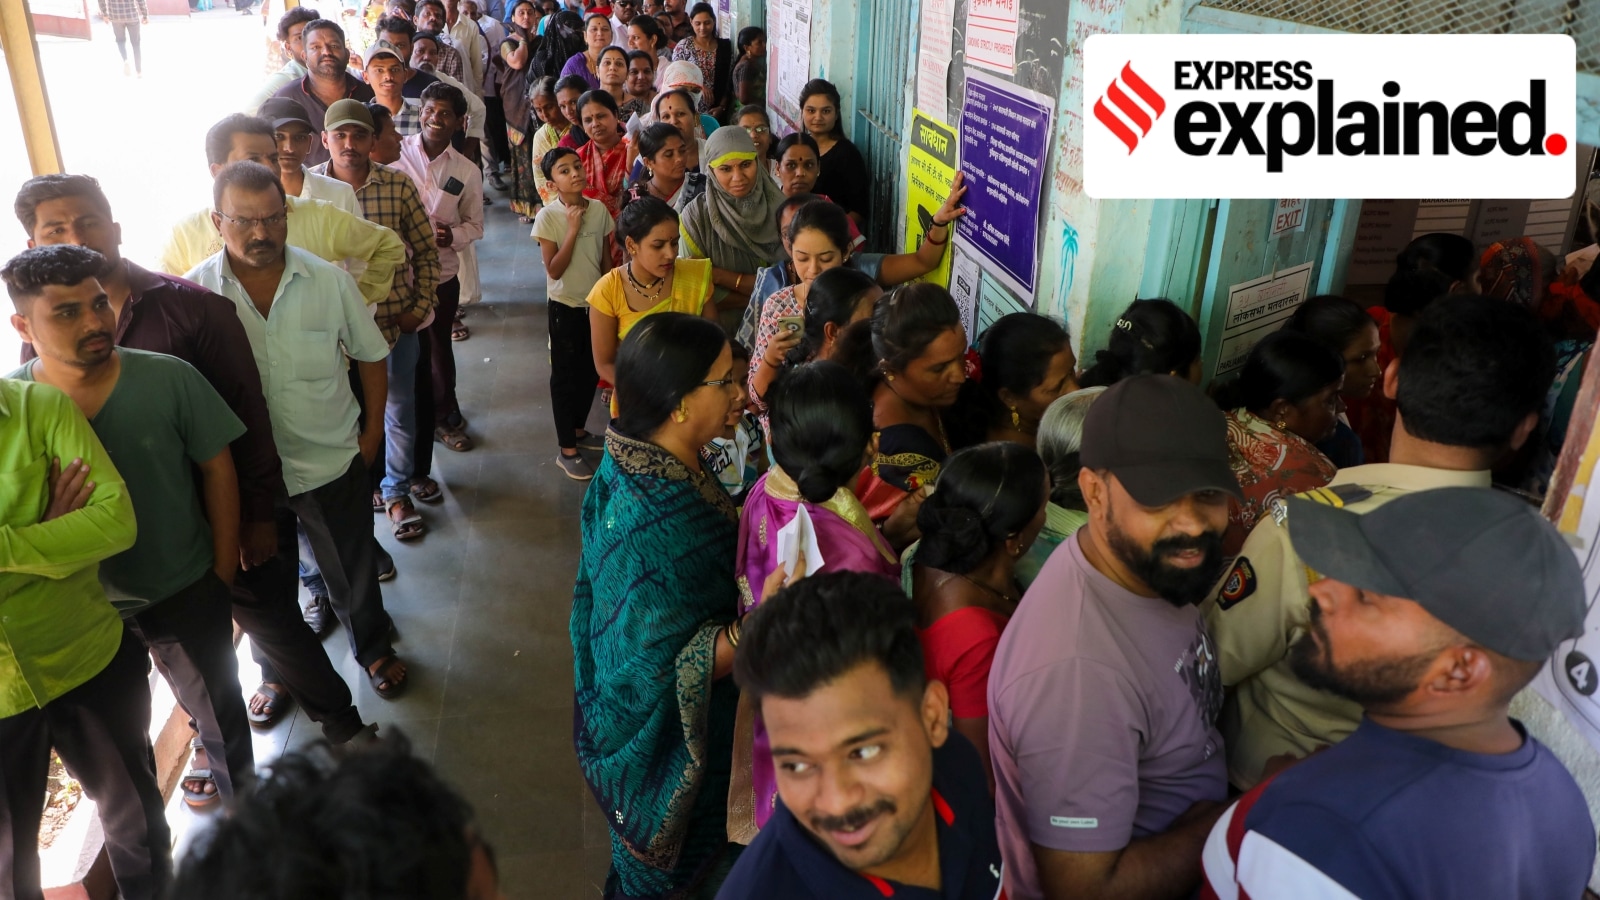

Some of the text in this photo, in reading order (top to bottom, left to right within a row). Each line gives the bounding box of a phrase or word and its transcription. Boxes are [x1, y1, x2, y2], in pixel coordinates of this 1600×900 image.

[919, 123, 948, 156] सावधान
[1276, 209, 1301, 230] EXIT
[1233, 292, 1300, 323] लोकसभा मतदारसंघ
[1570, 660, 1590, 690] 4
